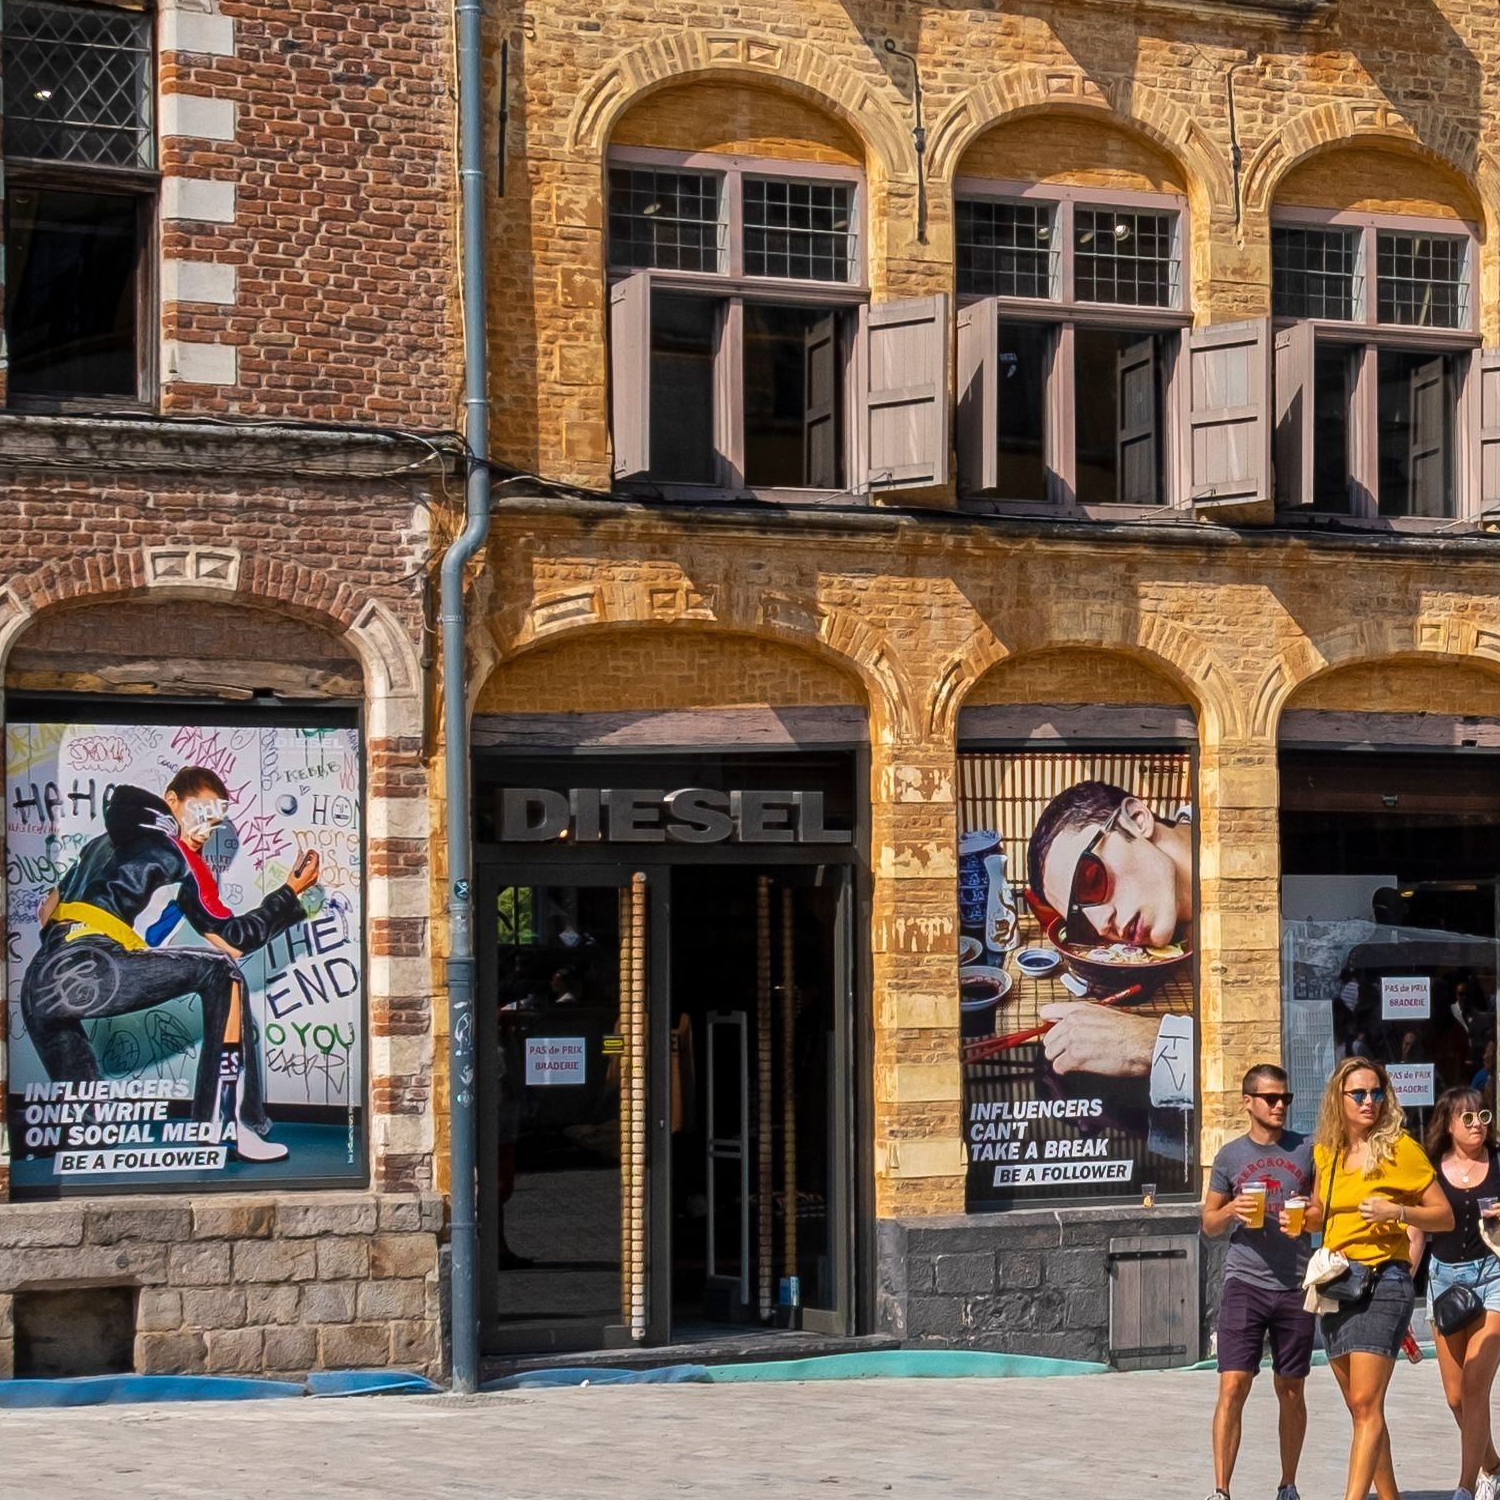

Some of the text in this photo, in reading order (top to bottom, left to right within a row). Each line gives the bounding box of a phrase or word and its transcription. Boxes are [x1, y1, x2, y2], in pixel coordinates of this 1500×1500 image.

[501, 787, 852, 843] DIESEL
[266, 957, 359, 1019] END
[1385, 984, 1399, 992] PAS
[1411, 984, 1428, 992] PRIX
[1389, 998, 1425, 1007] BRADERIE
[529, 1045, 547, 1055] PAS
[562, 1045, 582, 1054] PRIX
[535, 1061, 579, 1070] BRADERIE
[1414, 1070, 1431, 1078] PRIX
[23, 1078, 191, 1102] INFLUENCERS
[24, 1100, 170, 1124] ONLY WRITE
[969, 1098, 1103, 1121] INFLUENCERS
[25, 1121, 238, 1147] ON SOCIAL MEDIA
[970, 1121, 1028, 1142] CAN'T
[61, 1150, 220, 1171] BE A FOLLOWER
[971, 1138, 1109, 1162] TAKE A BREAK
[1000, 1164, 1127, 1183] BE A FOLLOWER
